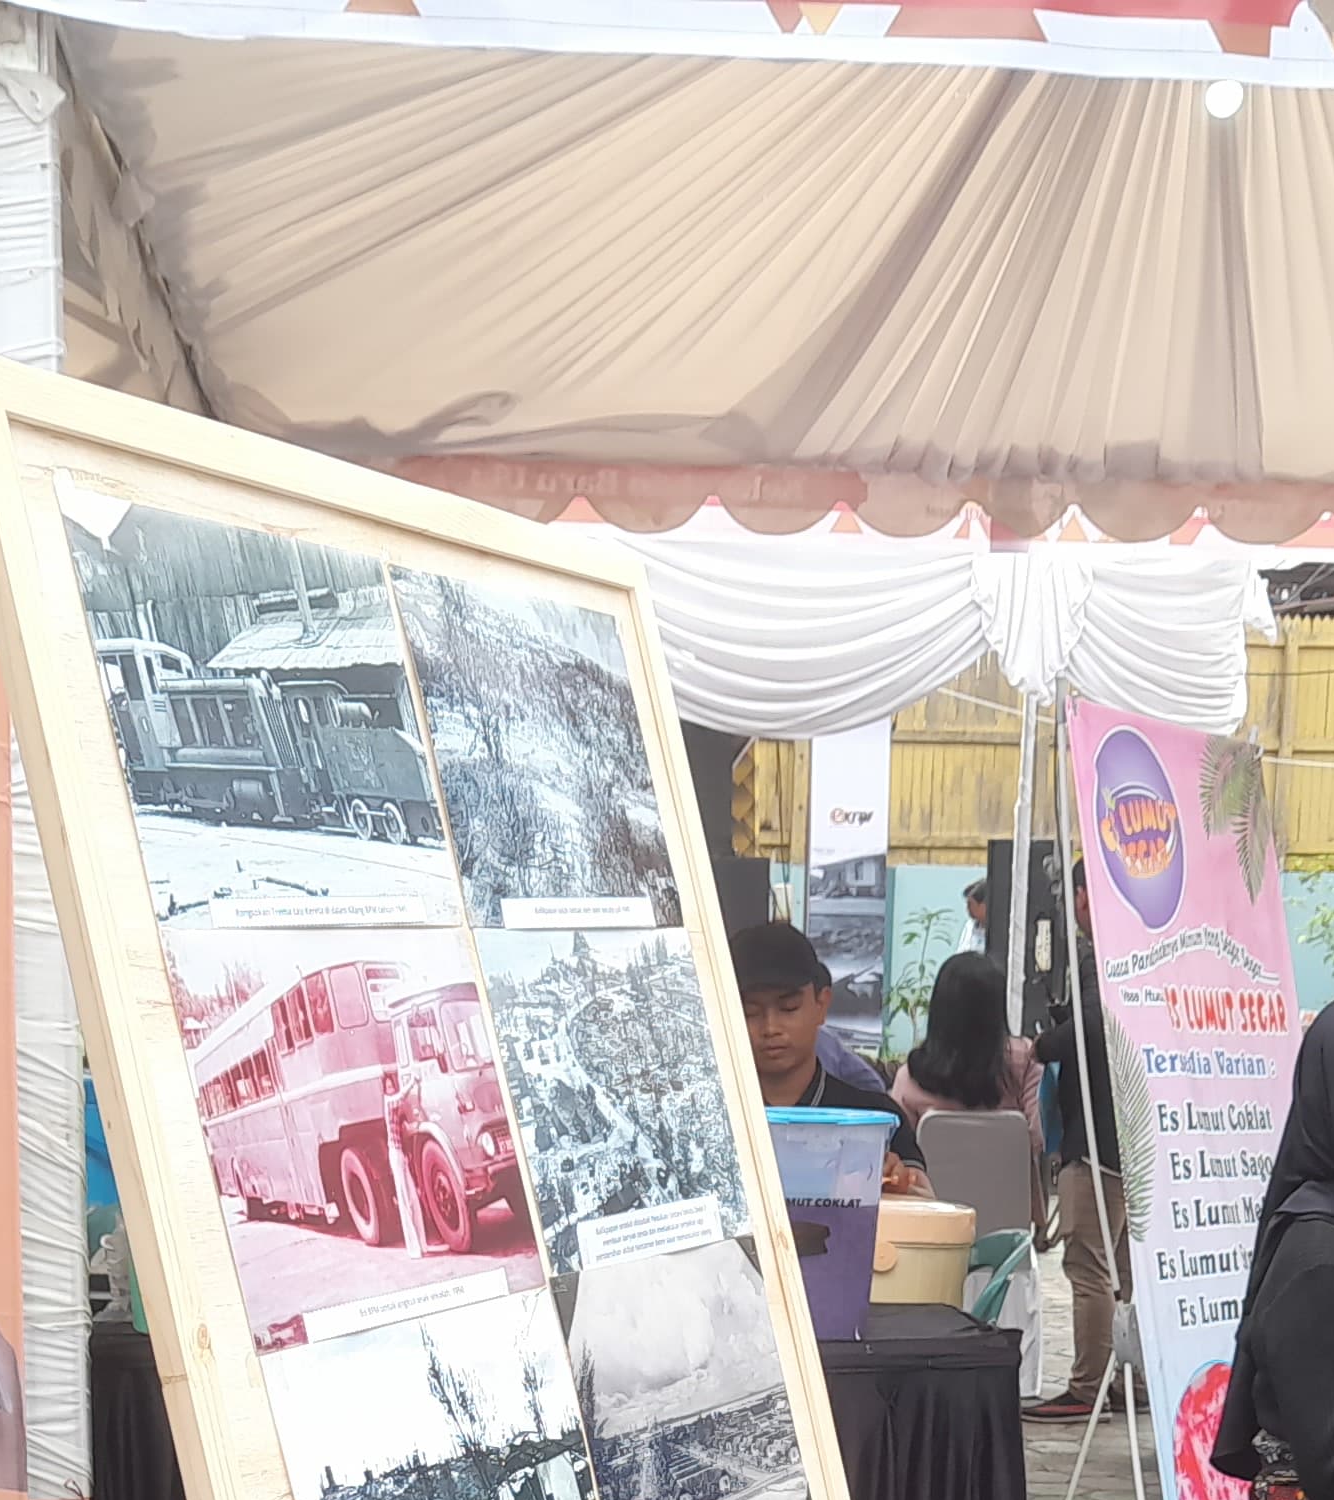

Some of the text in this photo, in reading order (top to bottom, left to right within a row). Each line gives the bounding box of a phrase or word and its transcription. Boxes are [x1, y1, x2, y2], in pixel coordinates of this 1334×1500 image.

[1183, 988, 1235, 1031] LUMUT
[1239, 990, 1288, 1033] SEGAR
[1214, 1050, 1266, 1076] Varian
[1158, 1103, 1180, 1132] Es
[1227, 1103, 1273, 1131] Coklat
[1170, 1151, 1192, 1180] Es
[785, 1197, 862, 1208] MUT COKLAT
[1171, 1201, 1188, 1229] Es
[1156, 1251, 1176, 1280] Es
[1179, 1249, 1240, 1277] Lumut
[1177, 1296, 1240, 1327] Es Lum
